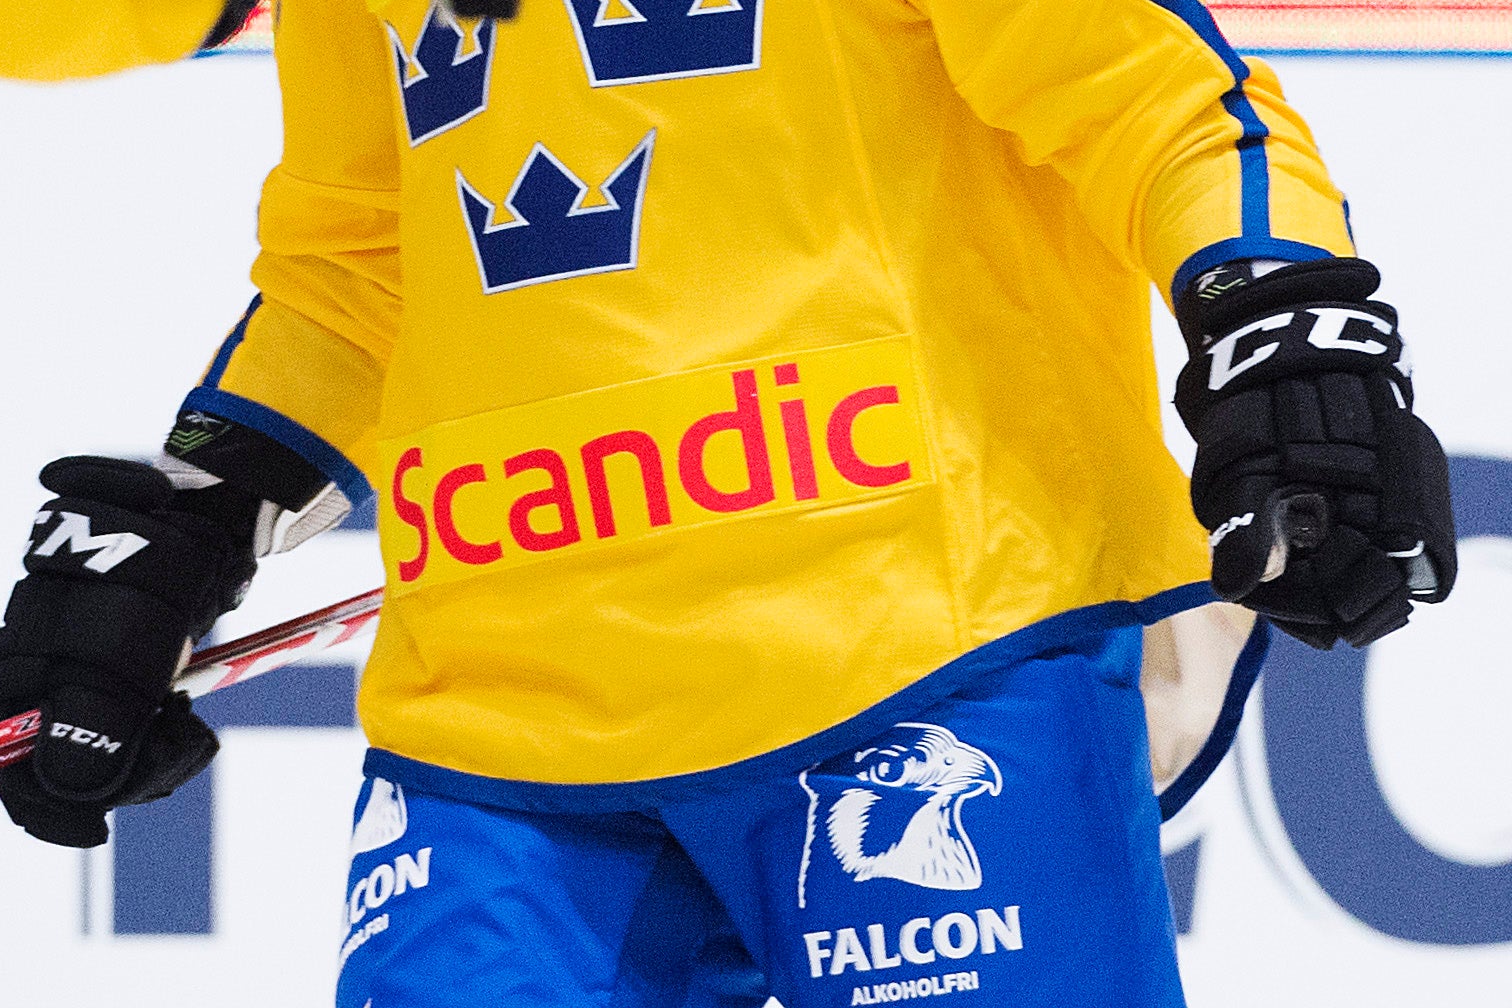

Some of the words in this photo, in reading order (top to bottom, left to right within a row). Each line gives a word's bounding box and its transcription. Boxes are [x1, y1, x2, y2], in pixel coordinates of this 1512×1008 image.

[391, 362, 913, 584] Scandic
[50, 722, 122, 753] CCM
[803, 905, 1024, 979] FALCON
[850, 970, 980, 1007] ALKOHOLFRI
